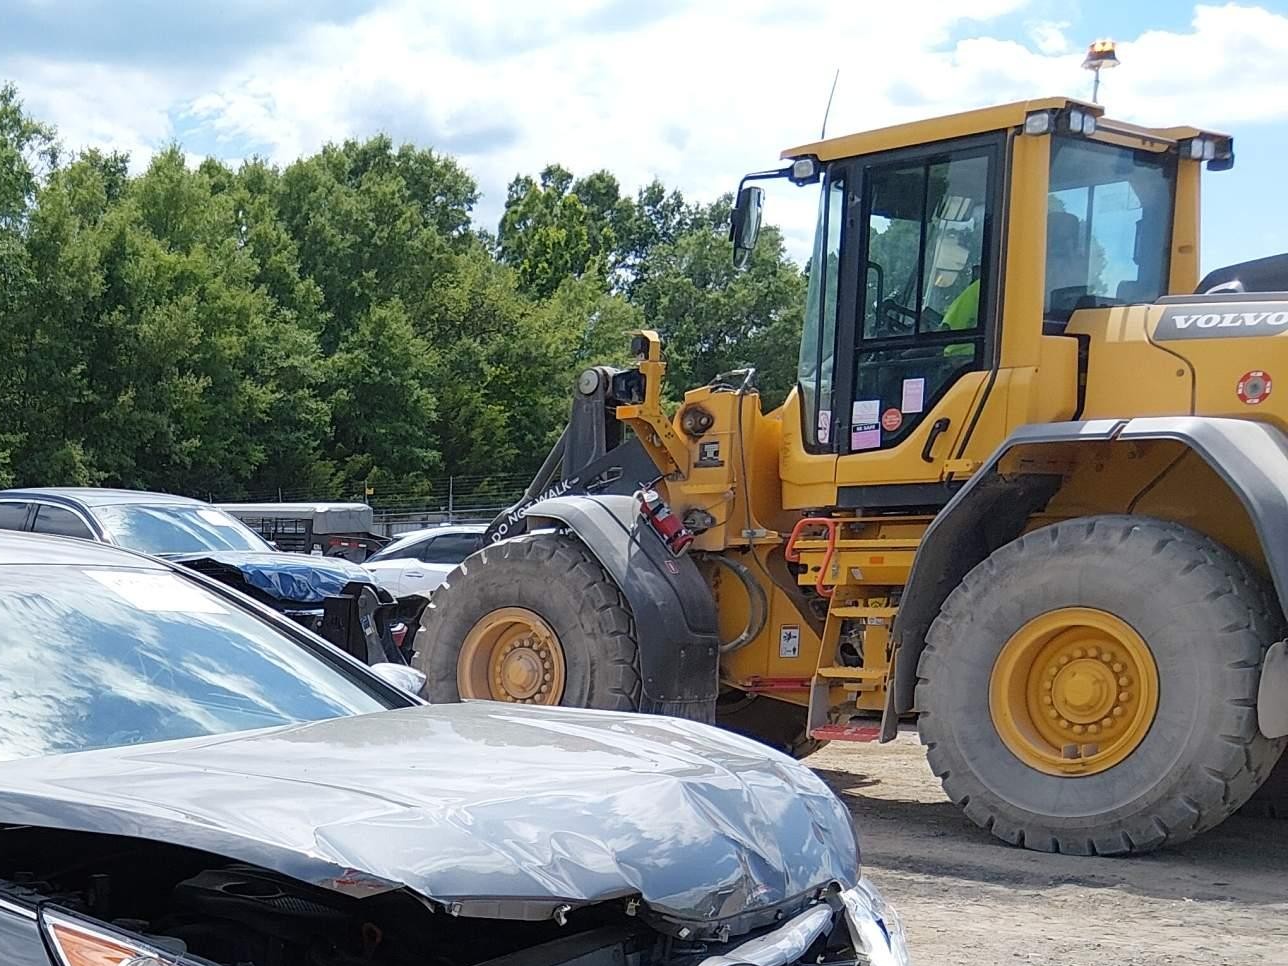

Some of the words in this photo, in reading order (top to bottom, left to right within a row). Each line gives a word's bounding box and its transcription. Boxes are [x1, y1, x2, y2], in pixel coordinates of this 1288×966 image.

[1172, 312, 1288, 329] VOLVO
[491, 523, 508, 542] DO
[508, 501, 534, 526] NOT
[535, 479, 571, 503] WALK
